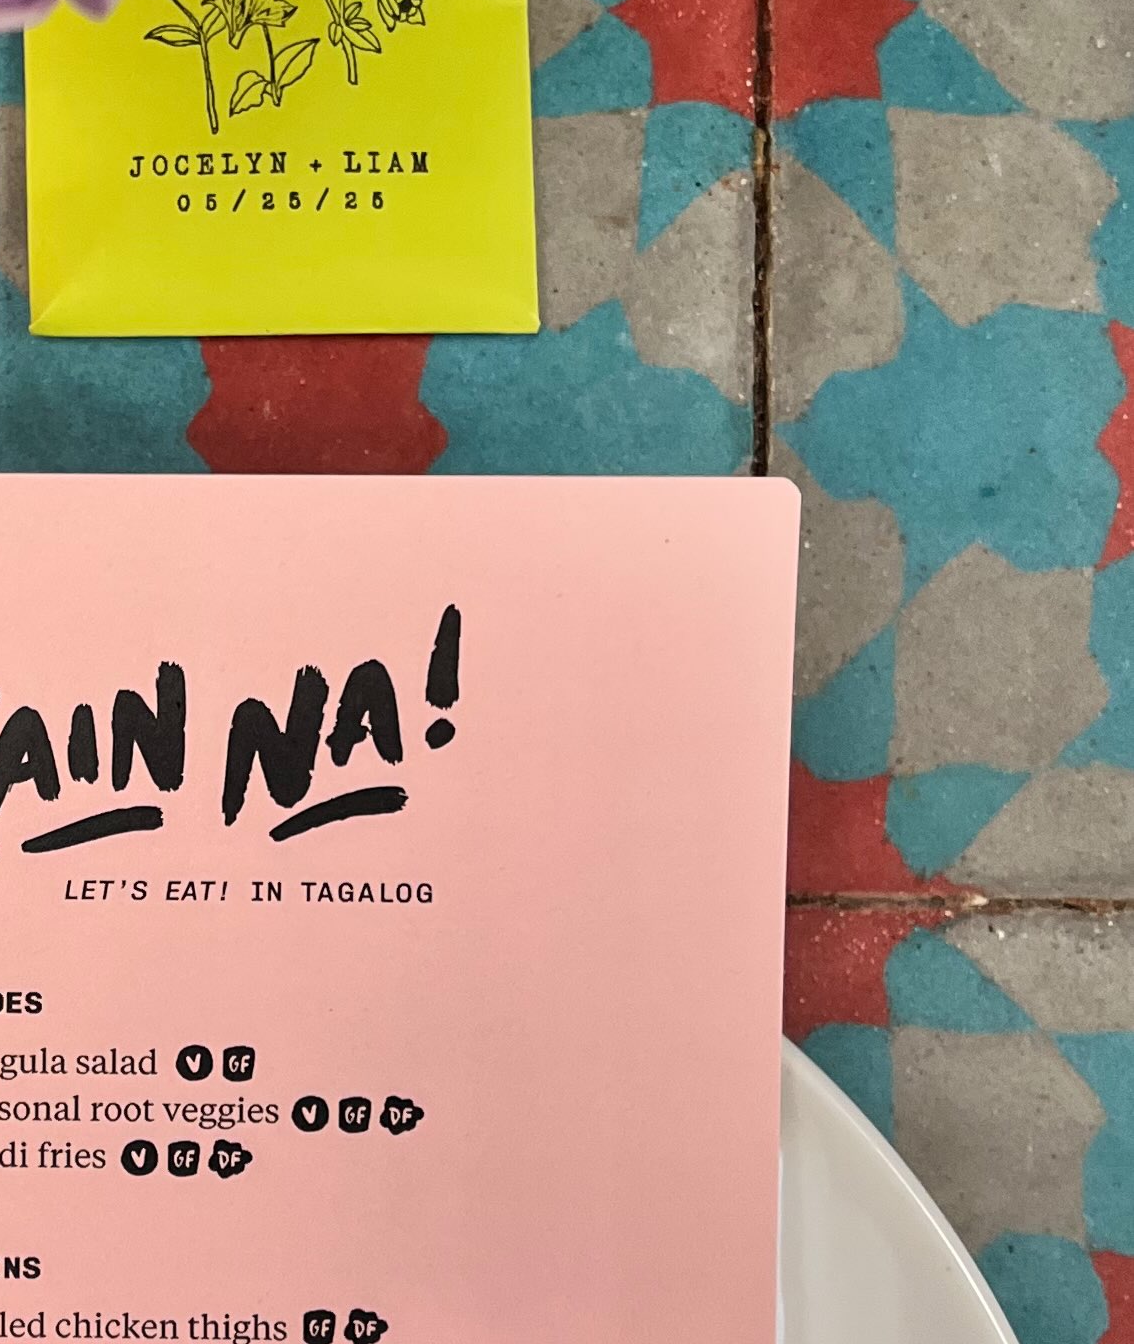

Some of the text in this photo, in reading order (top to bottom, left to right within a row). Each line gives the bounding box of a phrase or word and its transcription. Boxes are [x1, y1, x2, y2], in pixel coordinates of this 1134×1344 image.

[129, 150, 429, 178] JOCELYN + LIAM
[177, 187, 384, 212] 05/25/25
[221, 603, 462, 827] NA!
[64, 879, 433, 904] LET'S EAT! IN TAGALOG
[76, 1047, 158, 1076] salad
[90, 1099, 155, 1123] root
[162, 1096, 279, 1130] veggies
[38, 1141, 106, 1169] fries
[55, 1311, 179, 1340] chicken
